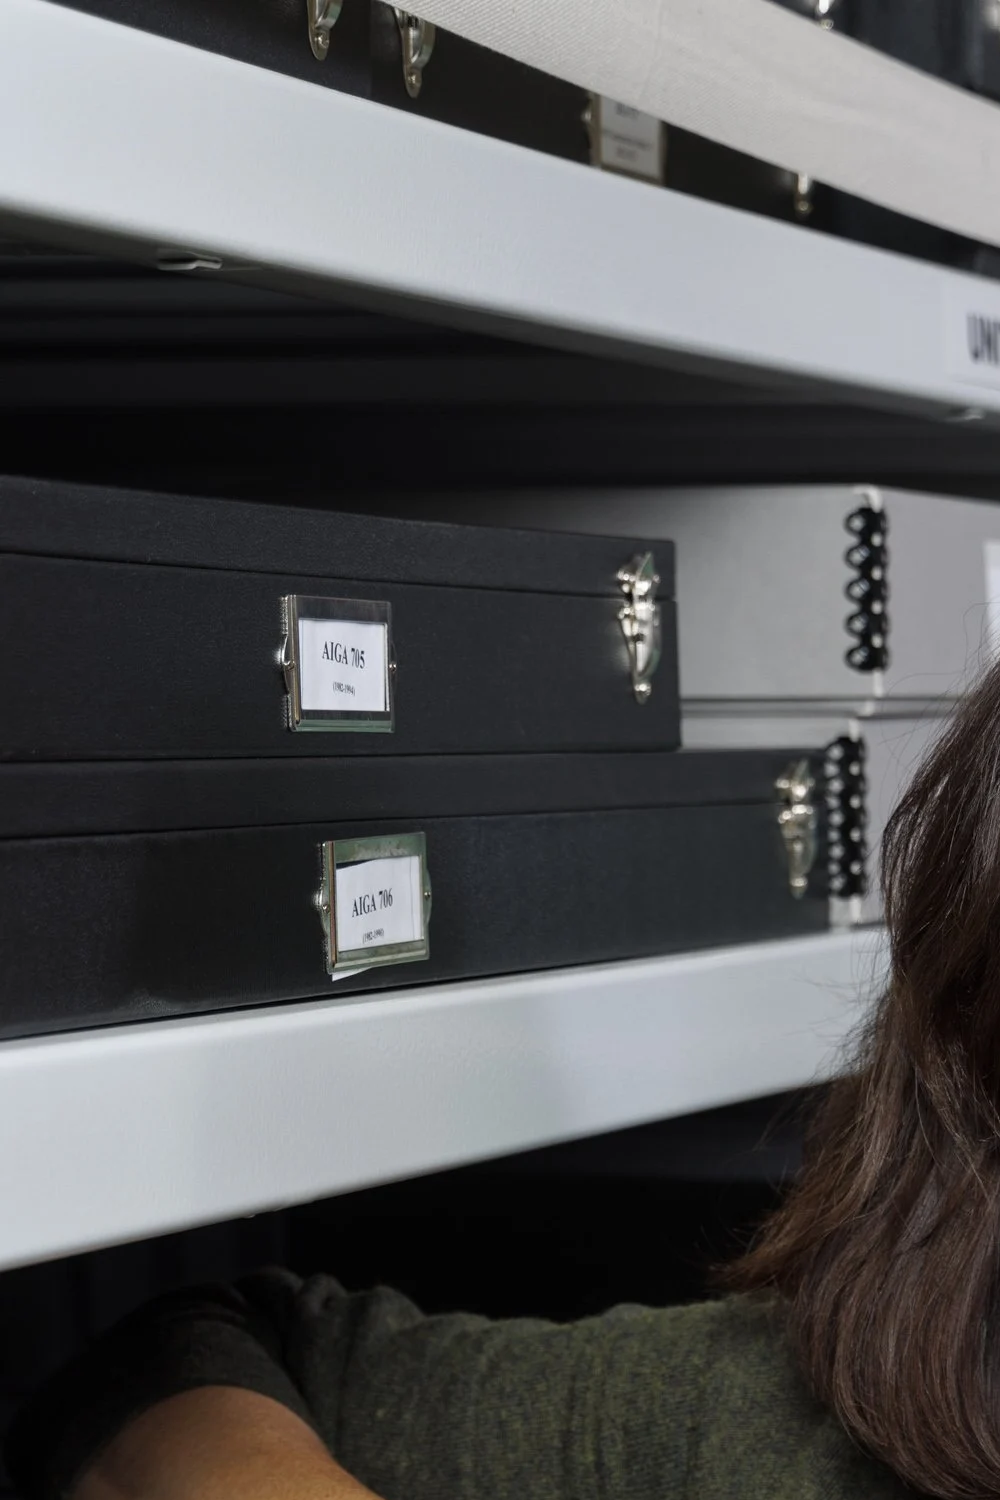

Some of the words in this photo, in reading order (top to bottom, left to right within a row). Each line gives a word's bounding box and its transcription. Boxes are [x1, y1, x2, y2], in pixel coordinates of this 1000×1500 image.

[322, 640, 348, 666] AIGA
[351, 646, 366, 670] 705
[351, 893, 377, 918] AIGA
[378, 887, 393, 910] 706
